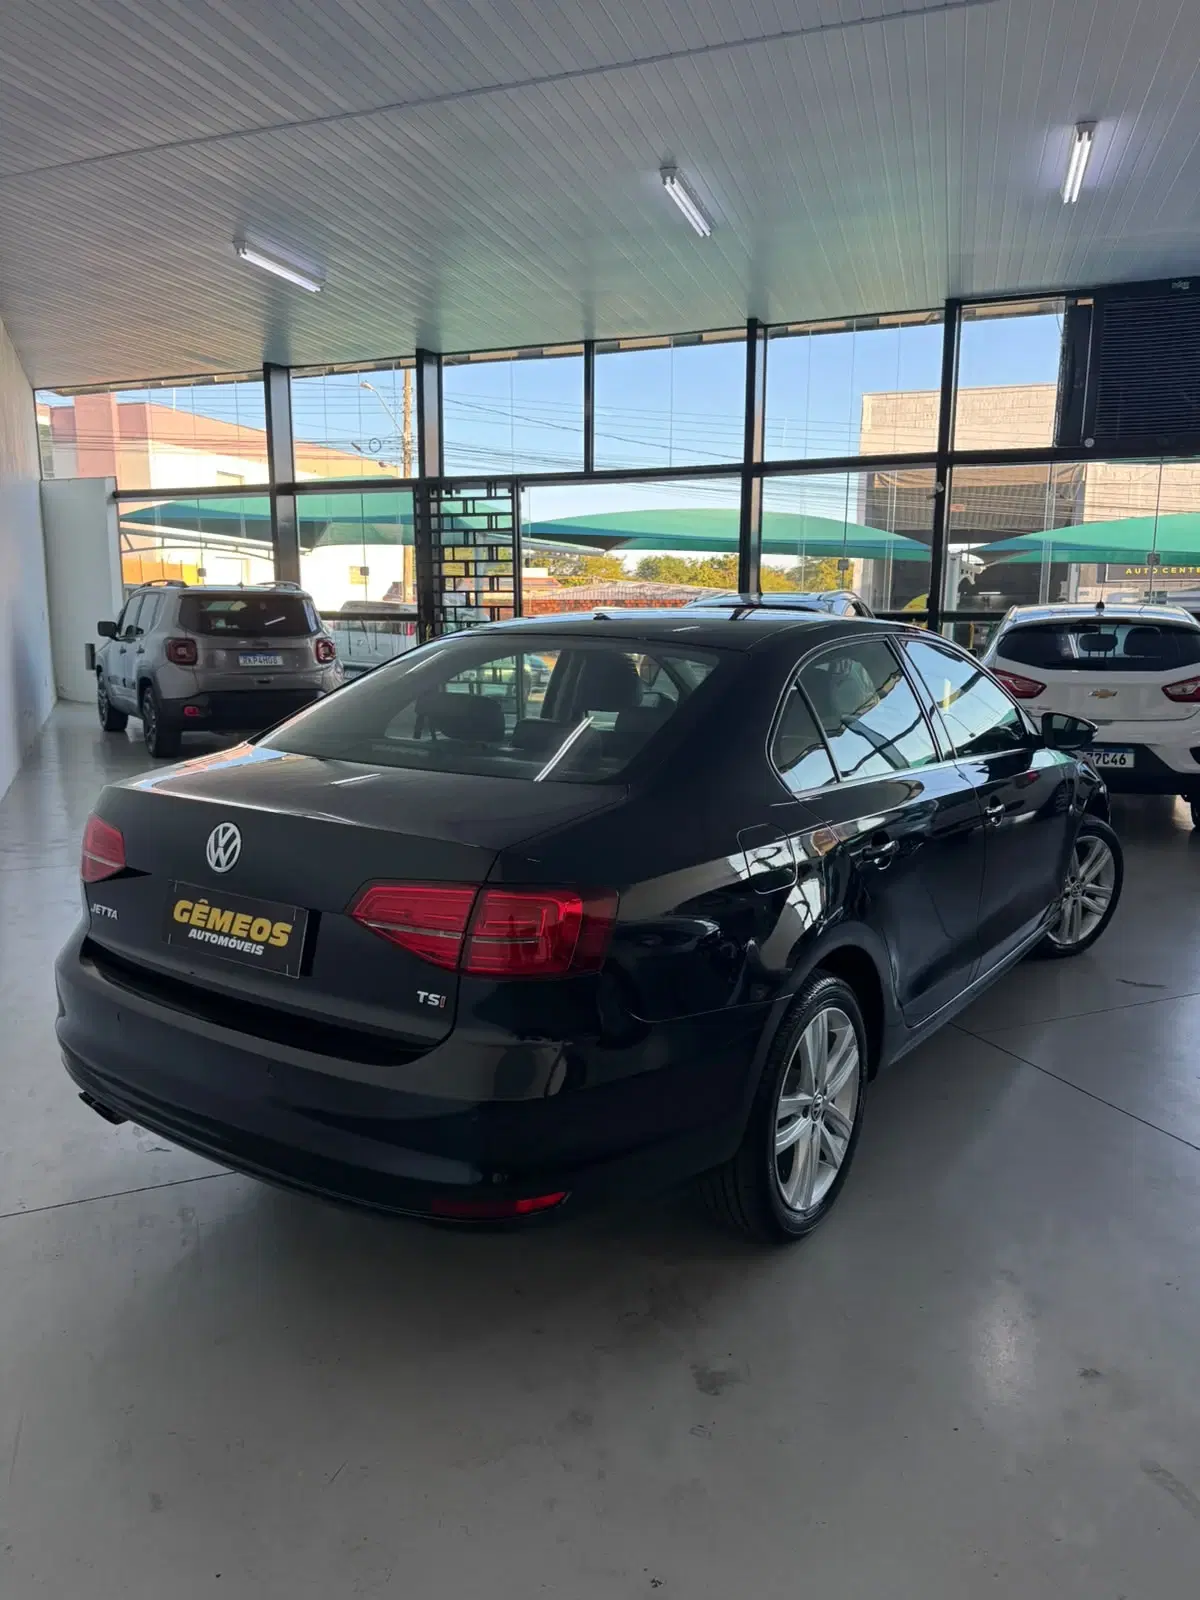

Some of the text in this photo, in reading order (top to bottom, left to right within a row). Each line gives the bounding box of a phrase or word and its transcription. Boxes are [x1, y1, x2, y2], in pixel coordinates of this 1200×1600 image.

[1125, 567, 1158, 575] AUTO
[90, 903, 118, 920] JETTA
[173, 898, 293, 948] GÊMEOS
[188, 928, 265, 956] AUTOMÓVEIS
